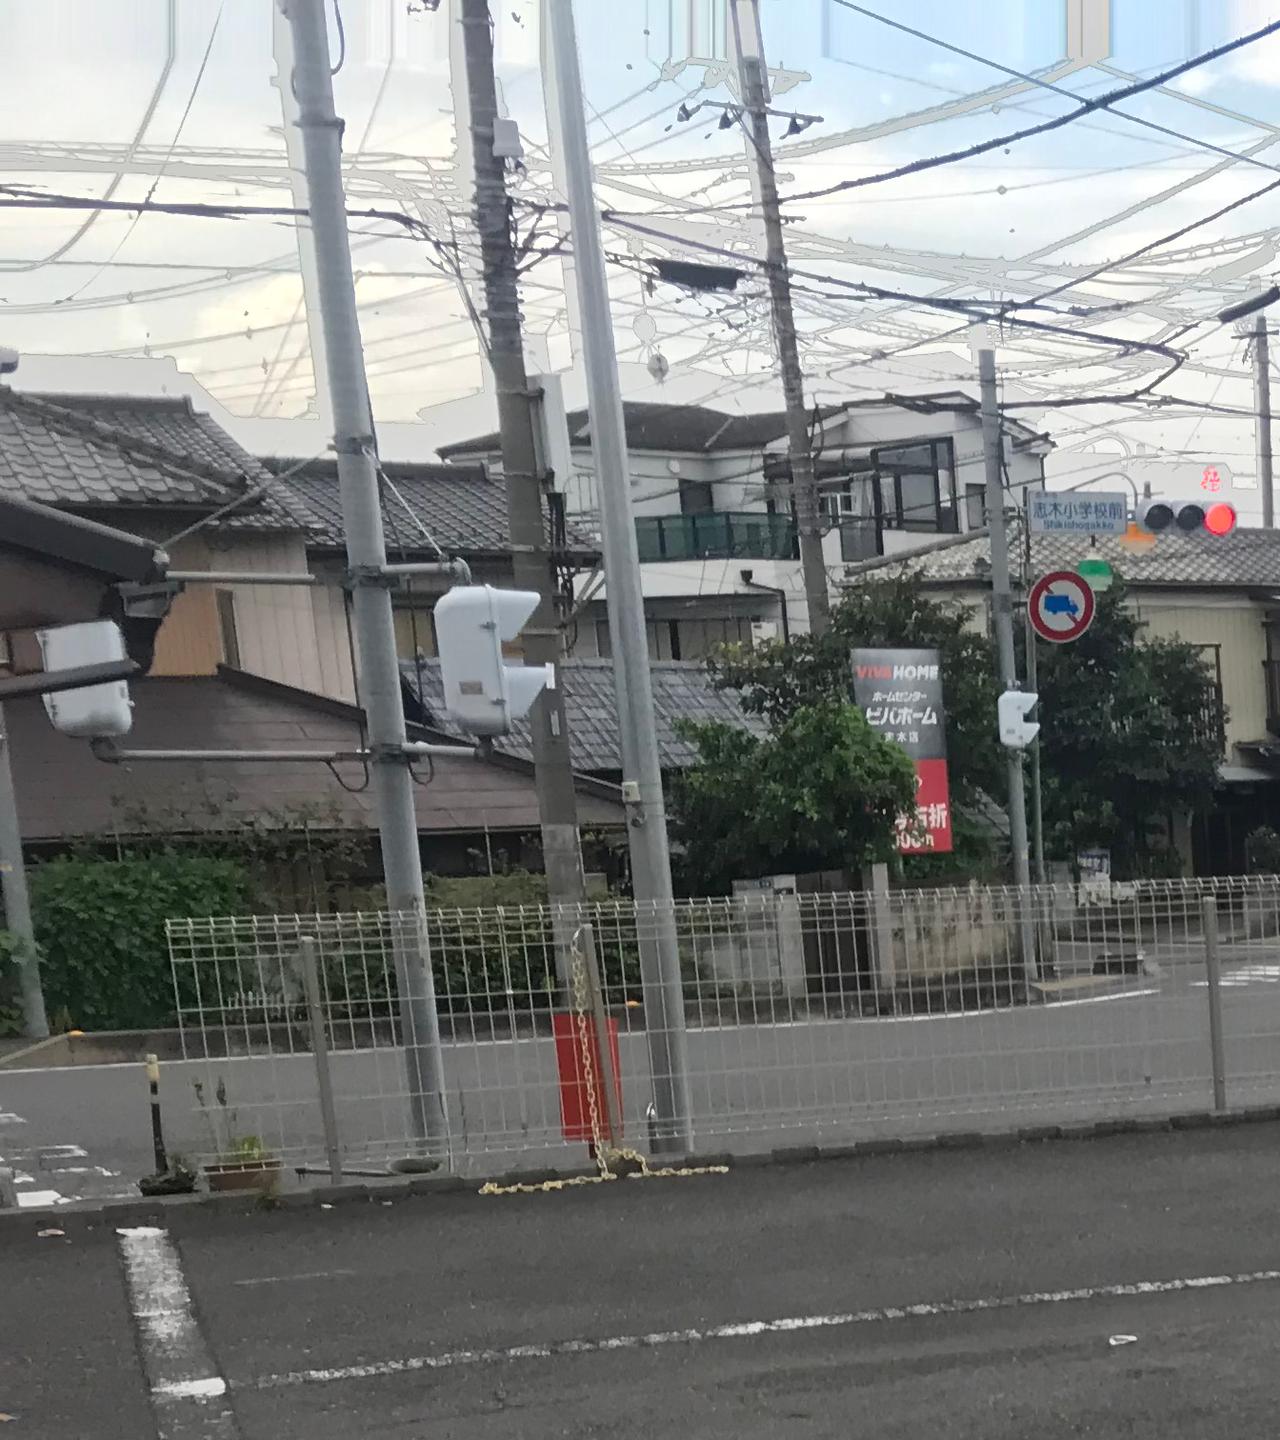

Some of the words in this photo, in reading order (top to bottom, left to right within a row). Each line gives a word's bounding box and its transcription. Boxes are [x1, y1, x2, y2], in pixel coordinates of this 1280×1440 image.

[1033, 502, 1123, 519] 志木小学校前
[871, 691, 928, 702] ホームセンター
[866, 706, 938, 725] ビバホーム
